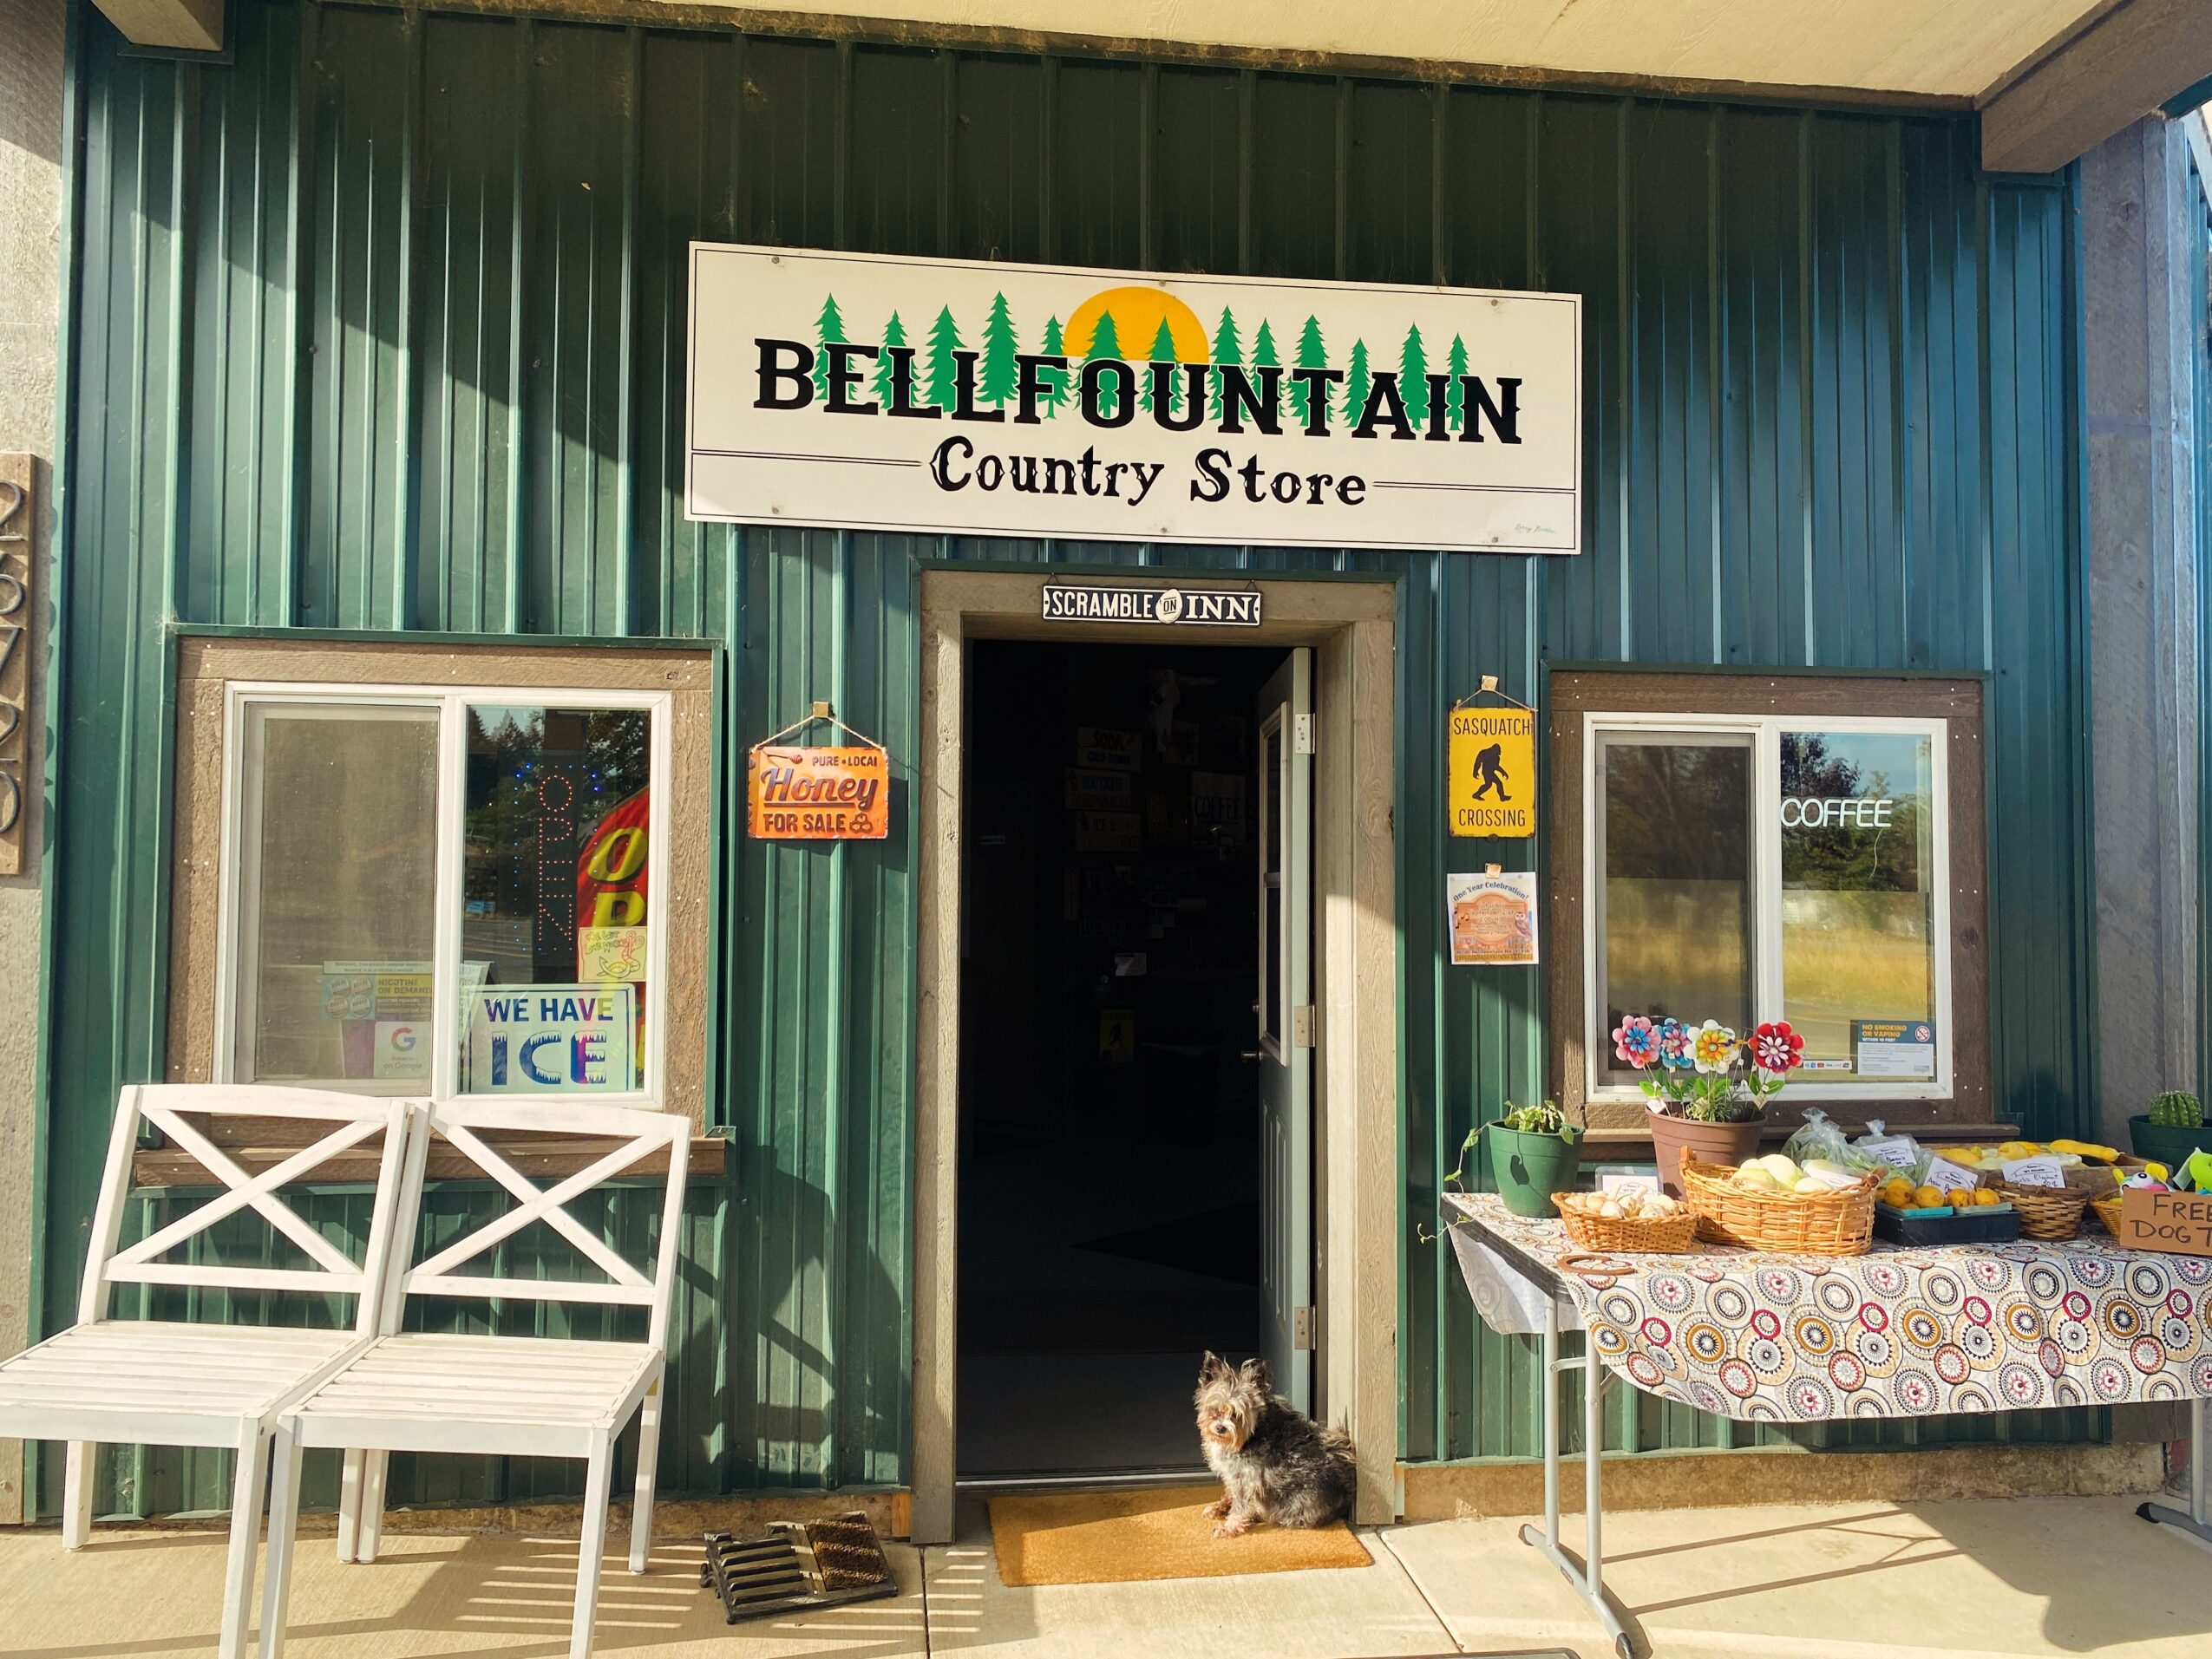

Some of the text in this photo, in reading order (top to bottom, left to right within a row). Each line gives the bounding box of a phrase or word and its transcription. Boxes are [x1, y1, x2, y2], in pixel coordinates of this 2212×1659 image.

[754, 337, 1522, 445] BELLFOUNTAIN
[930, 435, 1366, 506] Country Store
[1051, 591, 1253, 621] SCRAMBLE ON INN
[1453, 717, 1531, 736] SASQUATCH
[812, 756, 839, 767] PURE
[761, 767, 879, 812] Honey
[762, 813, 847, 833] FOR SALE
[1458, 809, 1526, 826] CROSSING
[1780, 798, 1894, 828] COFFEE
[540, 774, 573, 941] OPEN
[1453, 881, 1529, 901] One Year Celebration!
[484, 998, 613, 1022] WE HAVE
[391, 1027, 416, 1052] G
[491, 1030, 607, 1086] ICE
[2130, 1220, 2191, 1244] DOG
